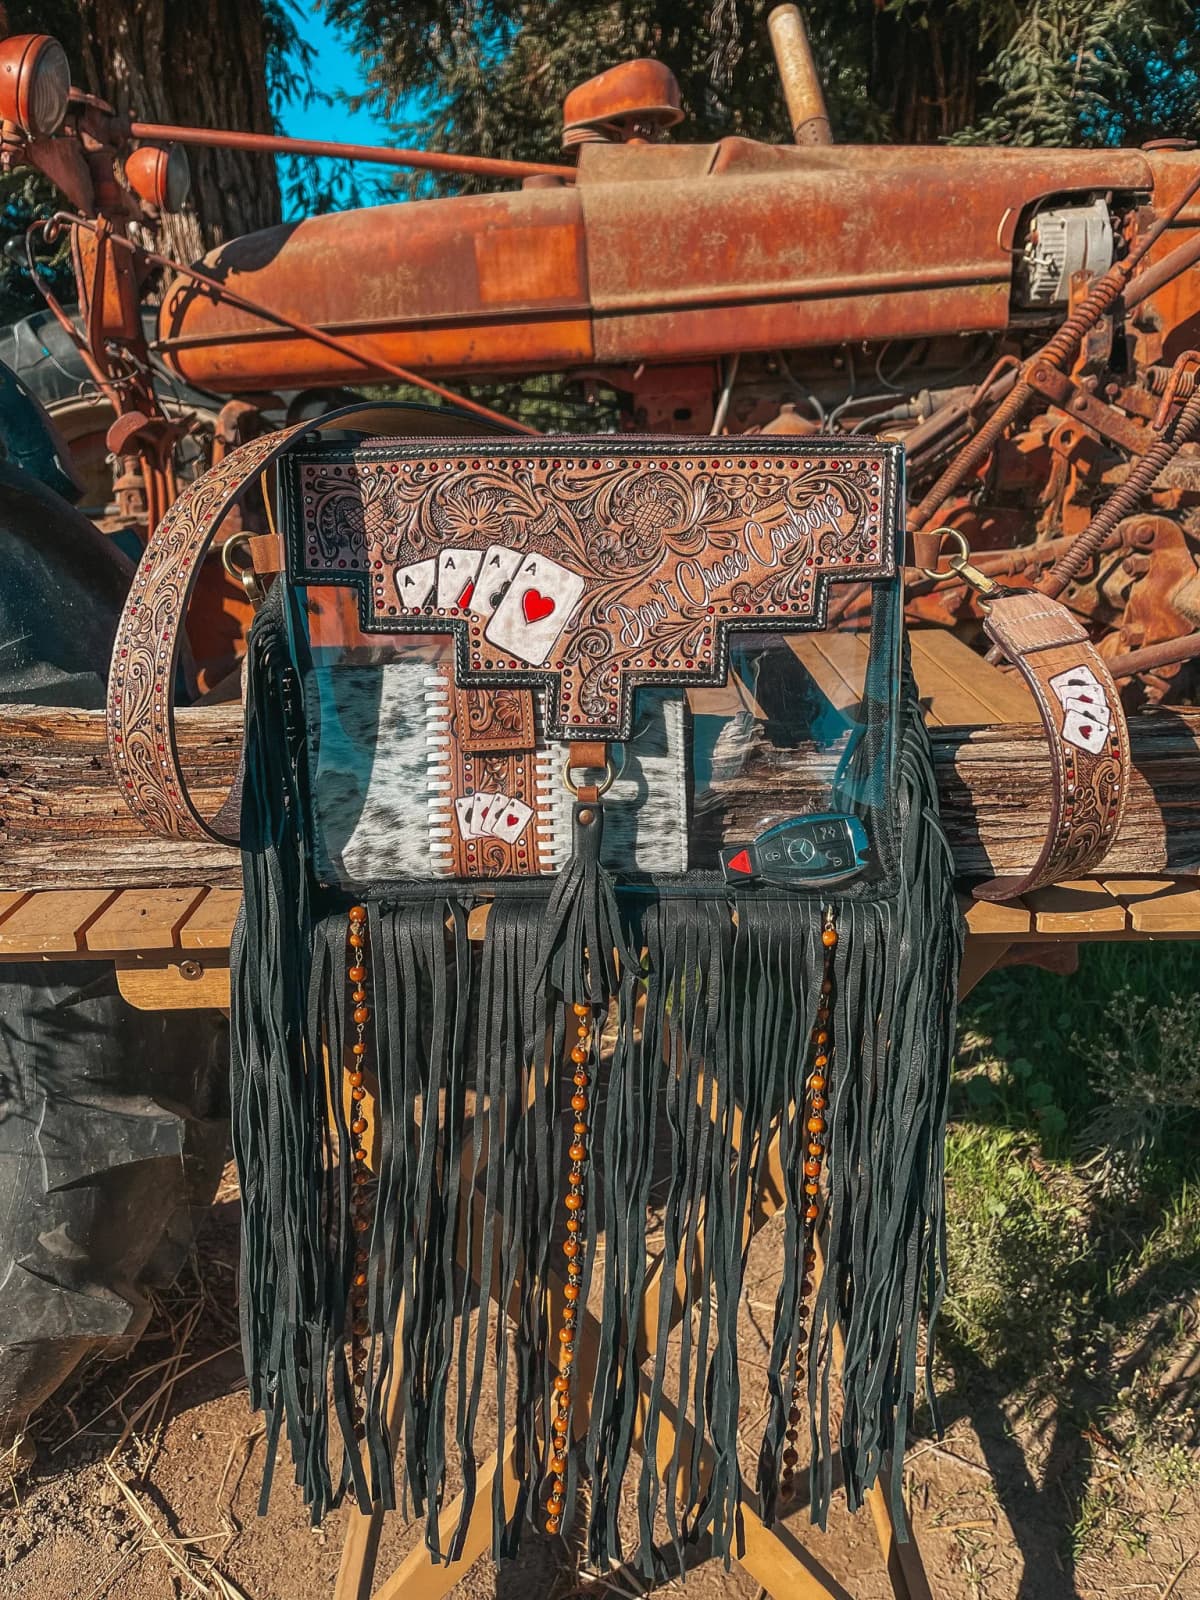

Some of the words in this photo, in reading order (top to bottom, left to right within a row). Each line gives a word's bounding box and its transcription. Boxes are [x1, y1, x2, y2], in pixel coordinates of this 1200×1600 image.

[444, 556, 457, 570] A
[489, 554, 501, 568] A
[525, 562, 537, 576] A
[604, 580, 680, 649] Don't
[675, 551, 749, 607] Chase
[744, 494, 842, 568] Cowboys
[404, 574, 416, 588] A
